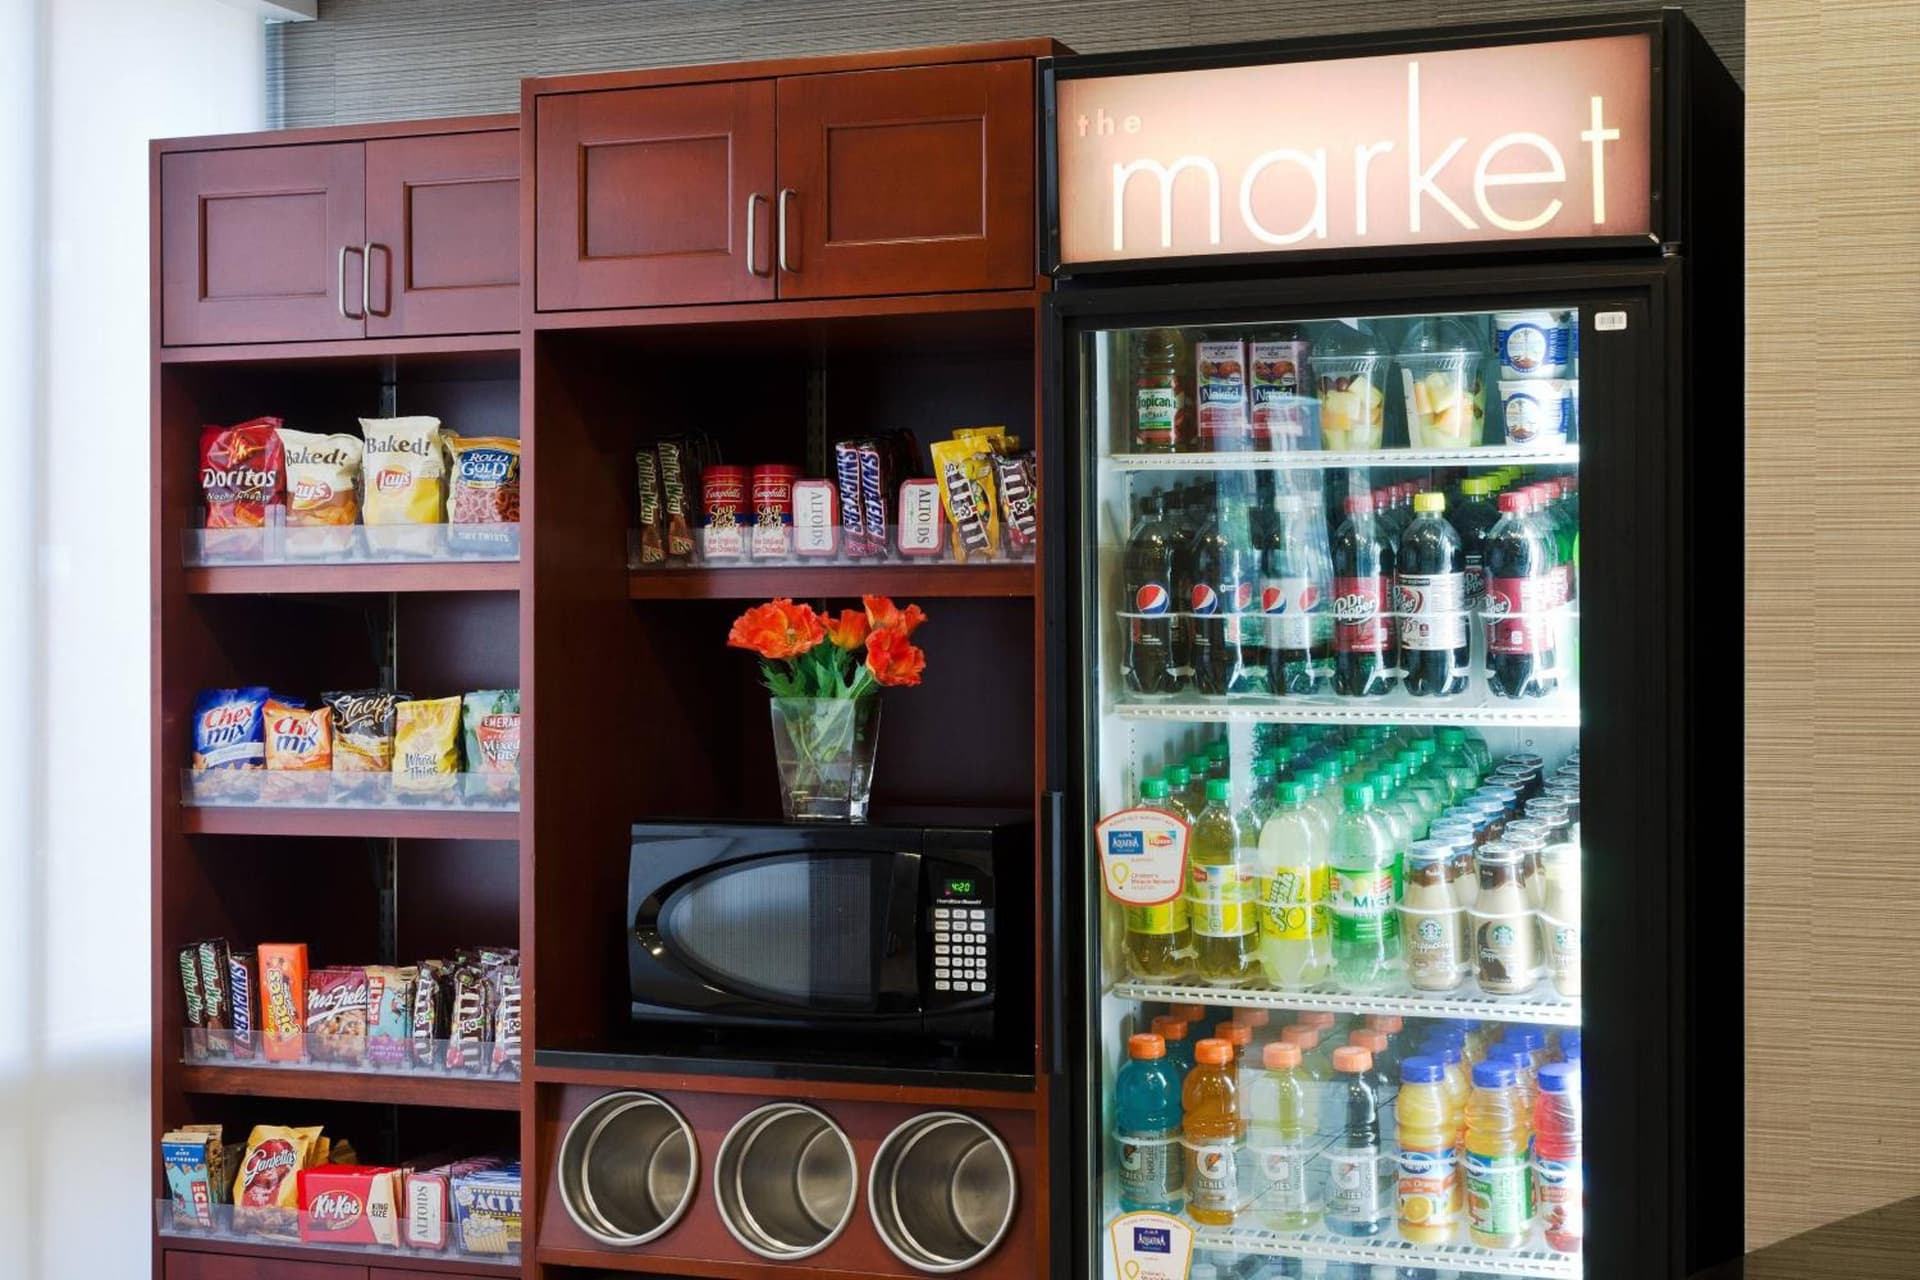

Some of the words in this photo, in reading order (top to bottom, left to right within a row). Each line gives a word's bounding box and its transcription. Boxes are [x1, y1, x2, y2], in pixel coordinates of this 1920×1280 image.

[1078, 108, 1142, 138] the
[1112, 60, 1621, 251] market
[286, 446, 348, 467] Baked!
[366, 435, 431, 457] Baked!
[202, 466, 277, 489] Doritos
[461, 461, 508, 477] GOLD
[837, 450, 863, 534] SNICKERS
[860, 453, 884, 538] SNICKERS
[811, 491, 824, 546] ALTOIDS
[917, 489, 931, 544] ALTOIDS
[1346, 594, 1365, 609] Dr
[204, 705, 252, 729] Chex
[484, 716, 520, 728] EMERAL
[207, 719, 251, 745] mix
[276, 731, 318, 753] mix
[230, 960, 249, 1042] SNICKERS
[331, 984, 367, 1018] Fiel
[371, 1210, 388, 1218] SIZE
[416, 1186, 428, 1238] ALTOIDS
